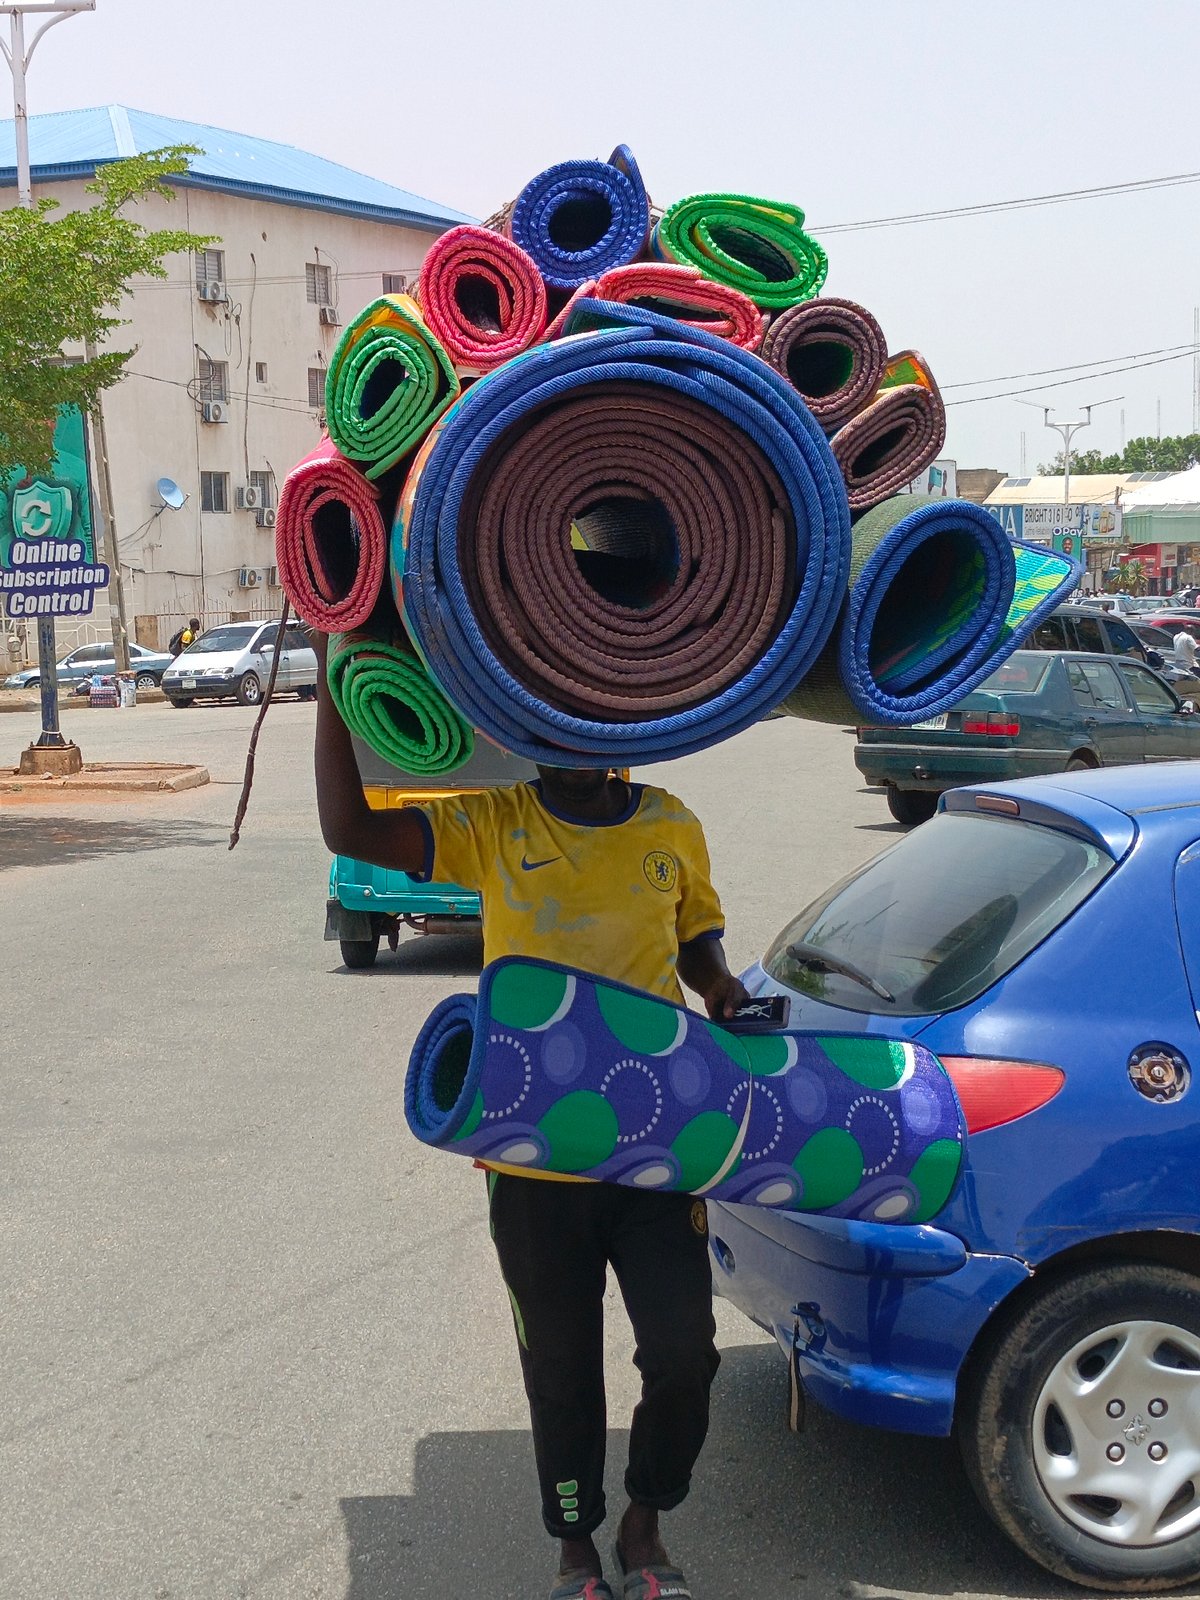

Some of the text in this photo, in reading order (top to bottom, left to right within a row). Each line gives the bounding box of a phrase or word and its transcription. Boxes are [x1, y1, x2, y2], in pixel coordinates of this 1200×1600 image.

[1024, 508, 1048, 523] BRIGHT
[1053, 526, 1083, 537] OPay
[12, 541, 82, 565] Online
[9, 589, 91, 615] Control
